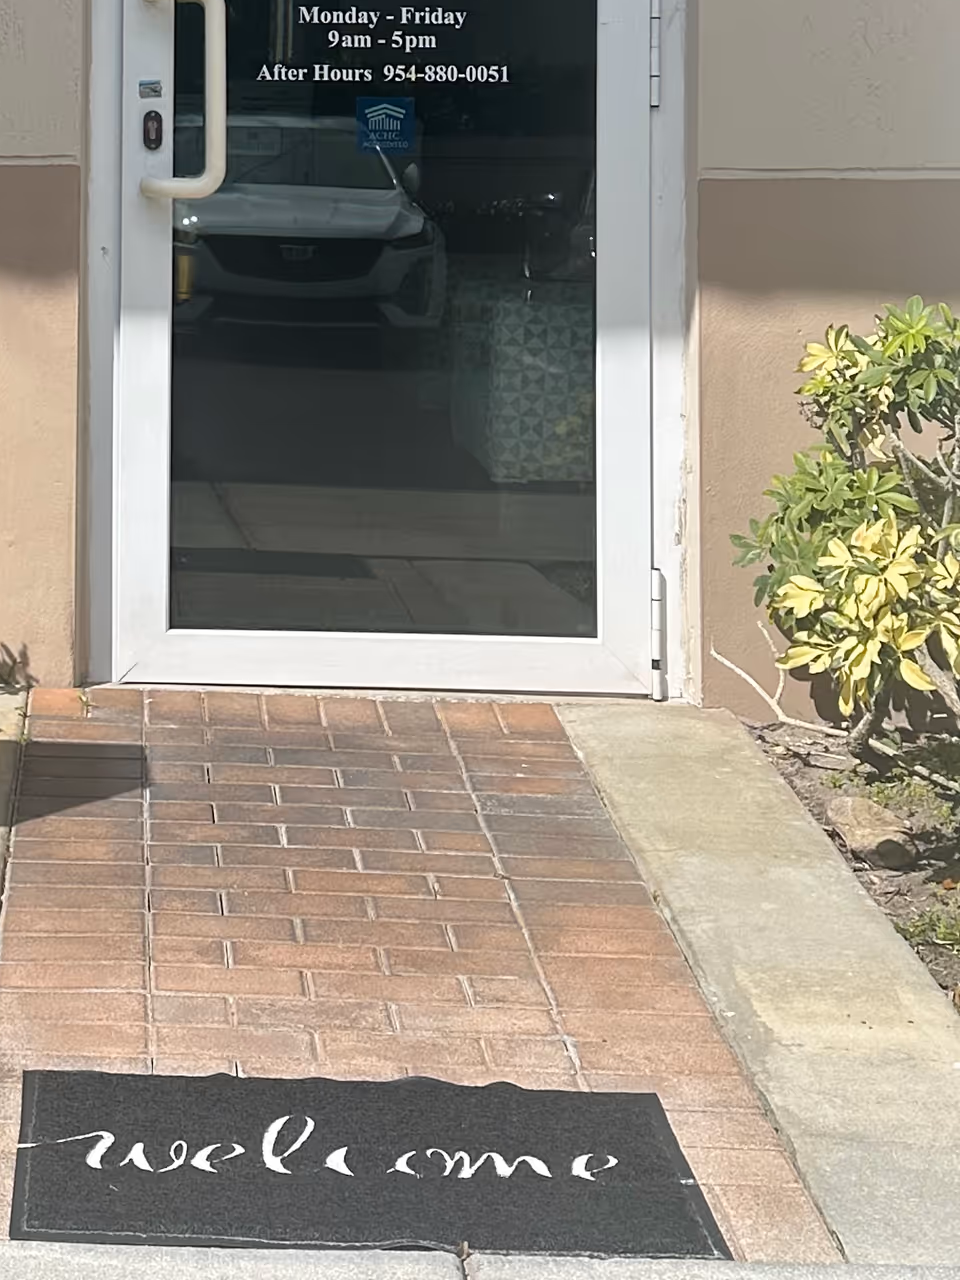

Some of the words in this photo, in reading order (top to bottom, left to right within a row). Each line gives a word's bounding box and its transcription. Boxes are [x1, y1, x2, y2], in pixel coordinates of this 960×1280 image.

[298, 6, 380, 29] Monday
[400, 7, 467, 29] Friday
[327, 30, 372, 48] 9am
[391, 31, 437, 52] 5pm
[256, 64, 307, 82] After
[312, 64, 372, 82] Hours
[383, 65, 510, 83] 954-880-0051
[17, 1114, 619, 1181] welcome
